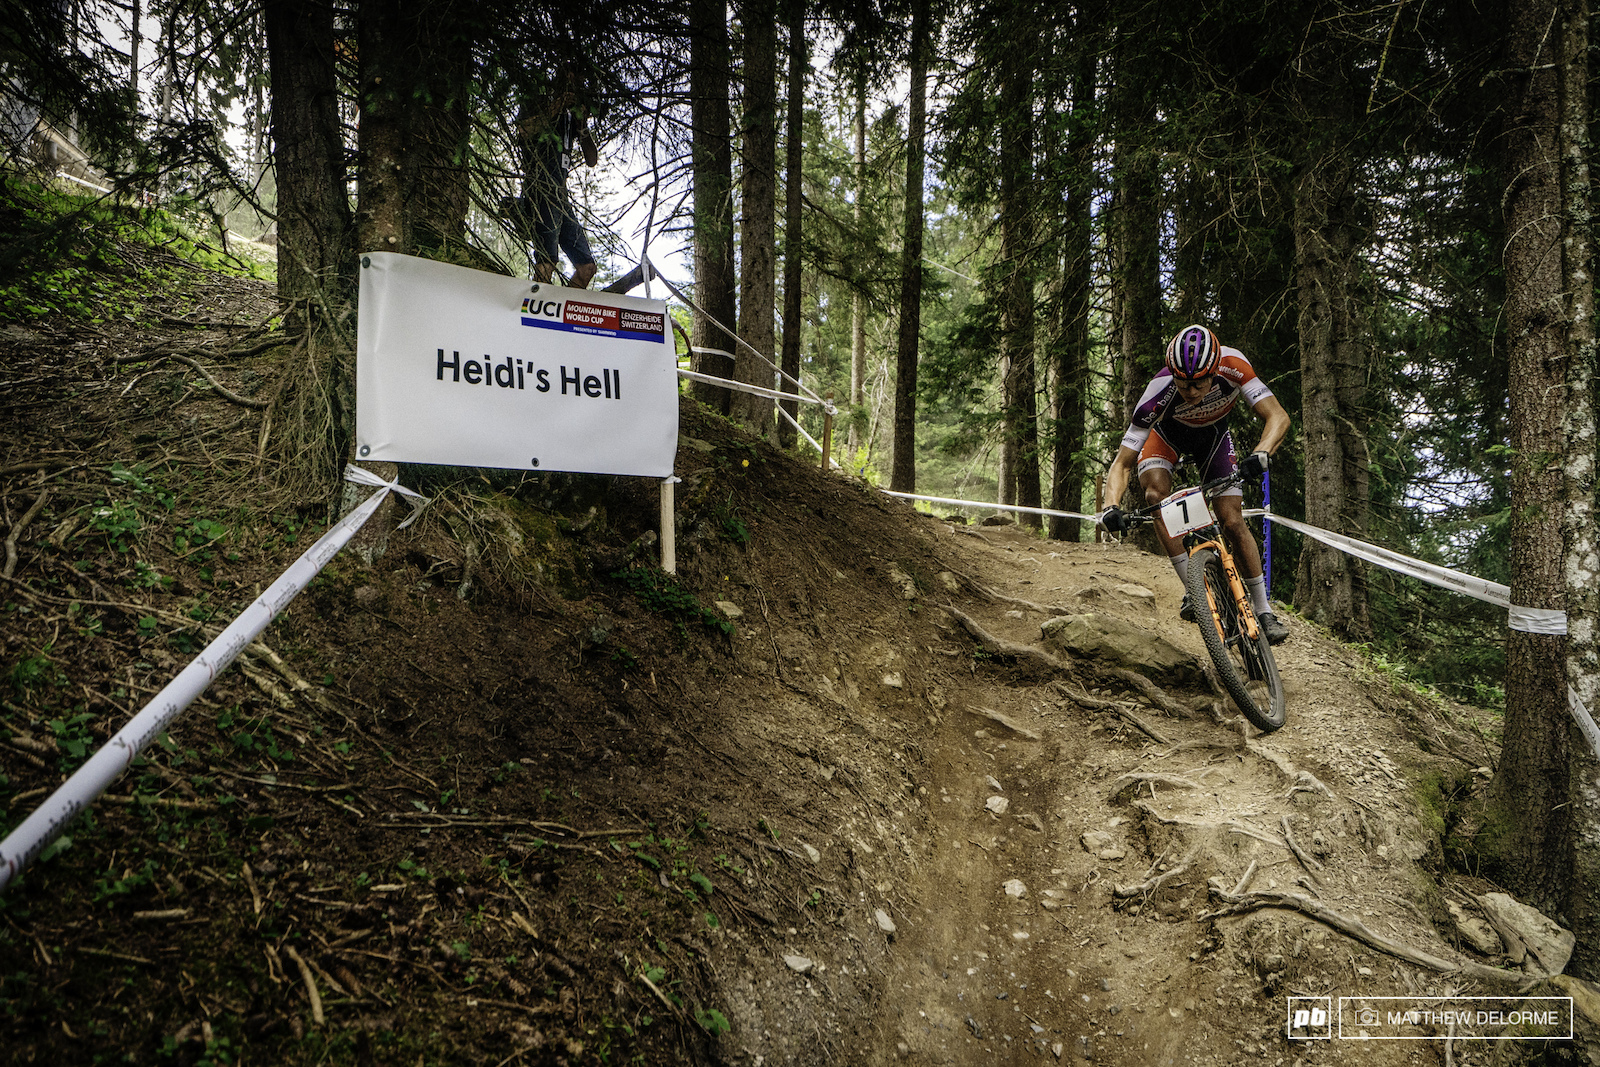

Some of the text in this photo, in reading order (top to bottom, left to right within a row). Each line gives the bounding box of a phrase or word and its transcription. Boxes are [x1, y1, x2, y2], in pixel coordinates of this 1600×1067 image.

[529, 299, 562, 318] UCI
[566, 303, 617, 318] MOUNTAIN BIKE
[565, 312, 604, 325] WORLD CUP
[621, 312, 662, 323] LENZERHEIDE
[621, 320, 663, 332] SWITZERLAND
[560, 365, 621, 400] Hell
[1176, 499, 1190, 525] 7
